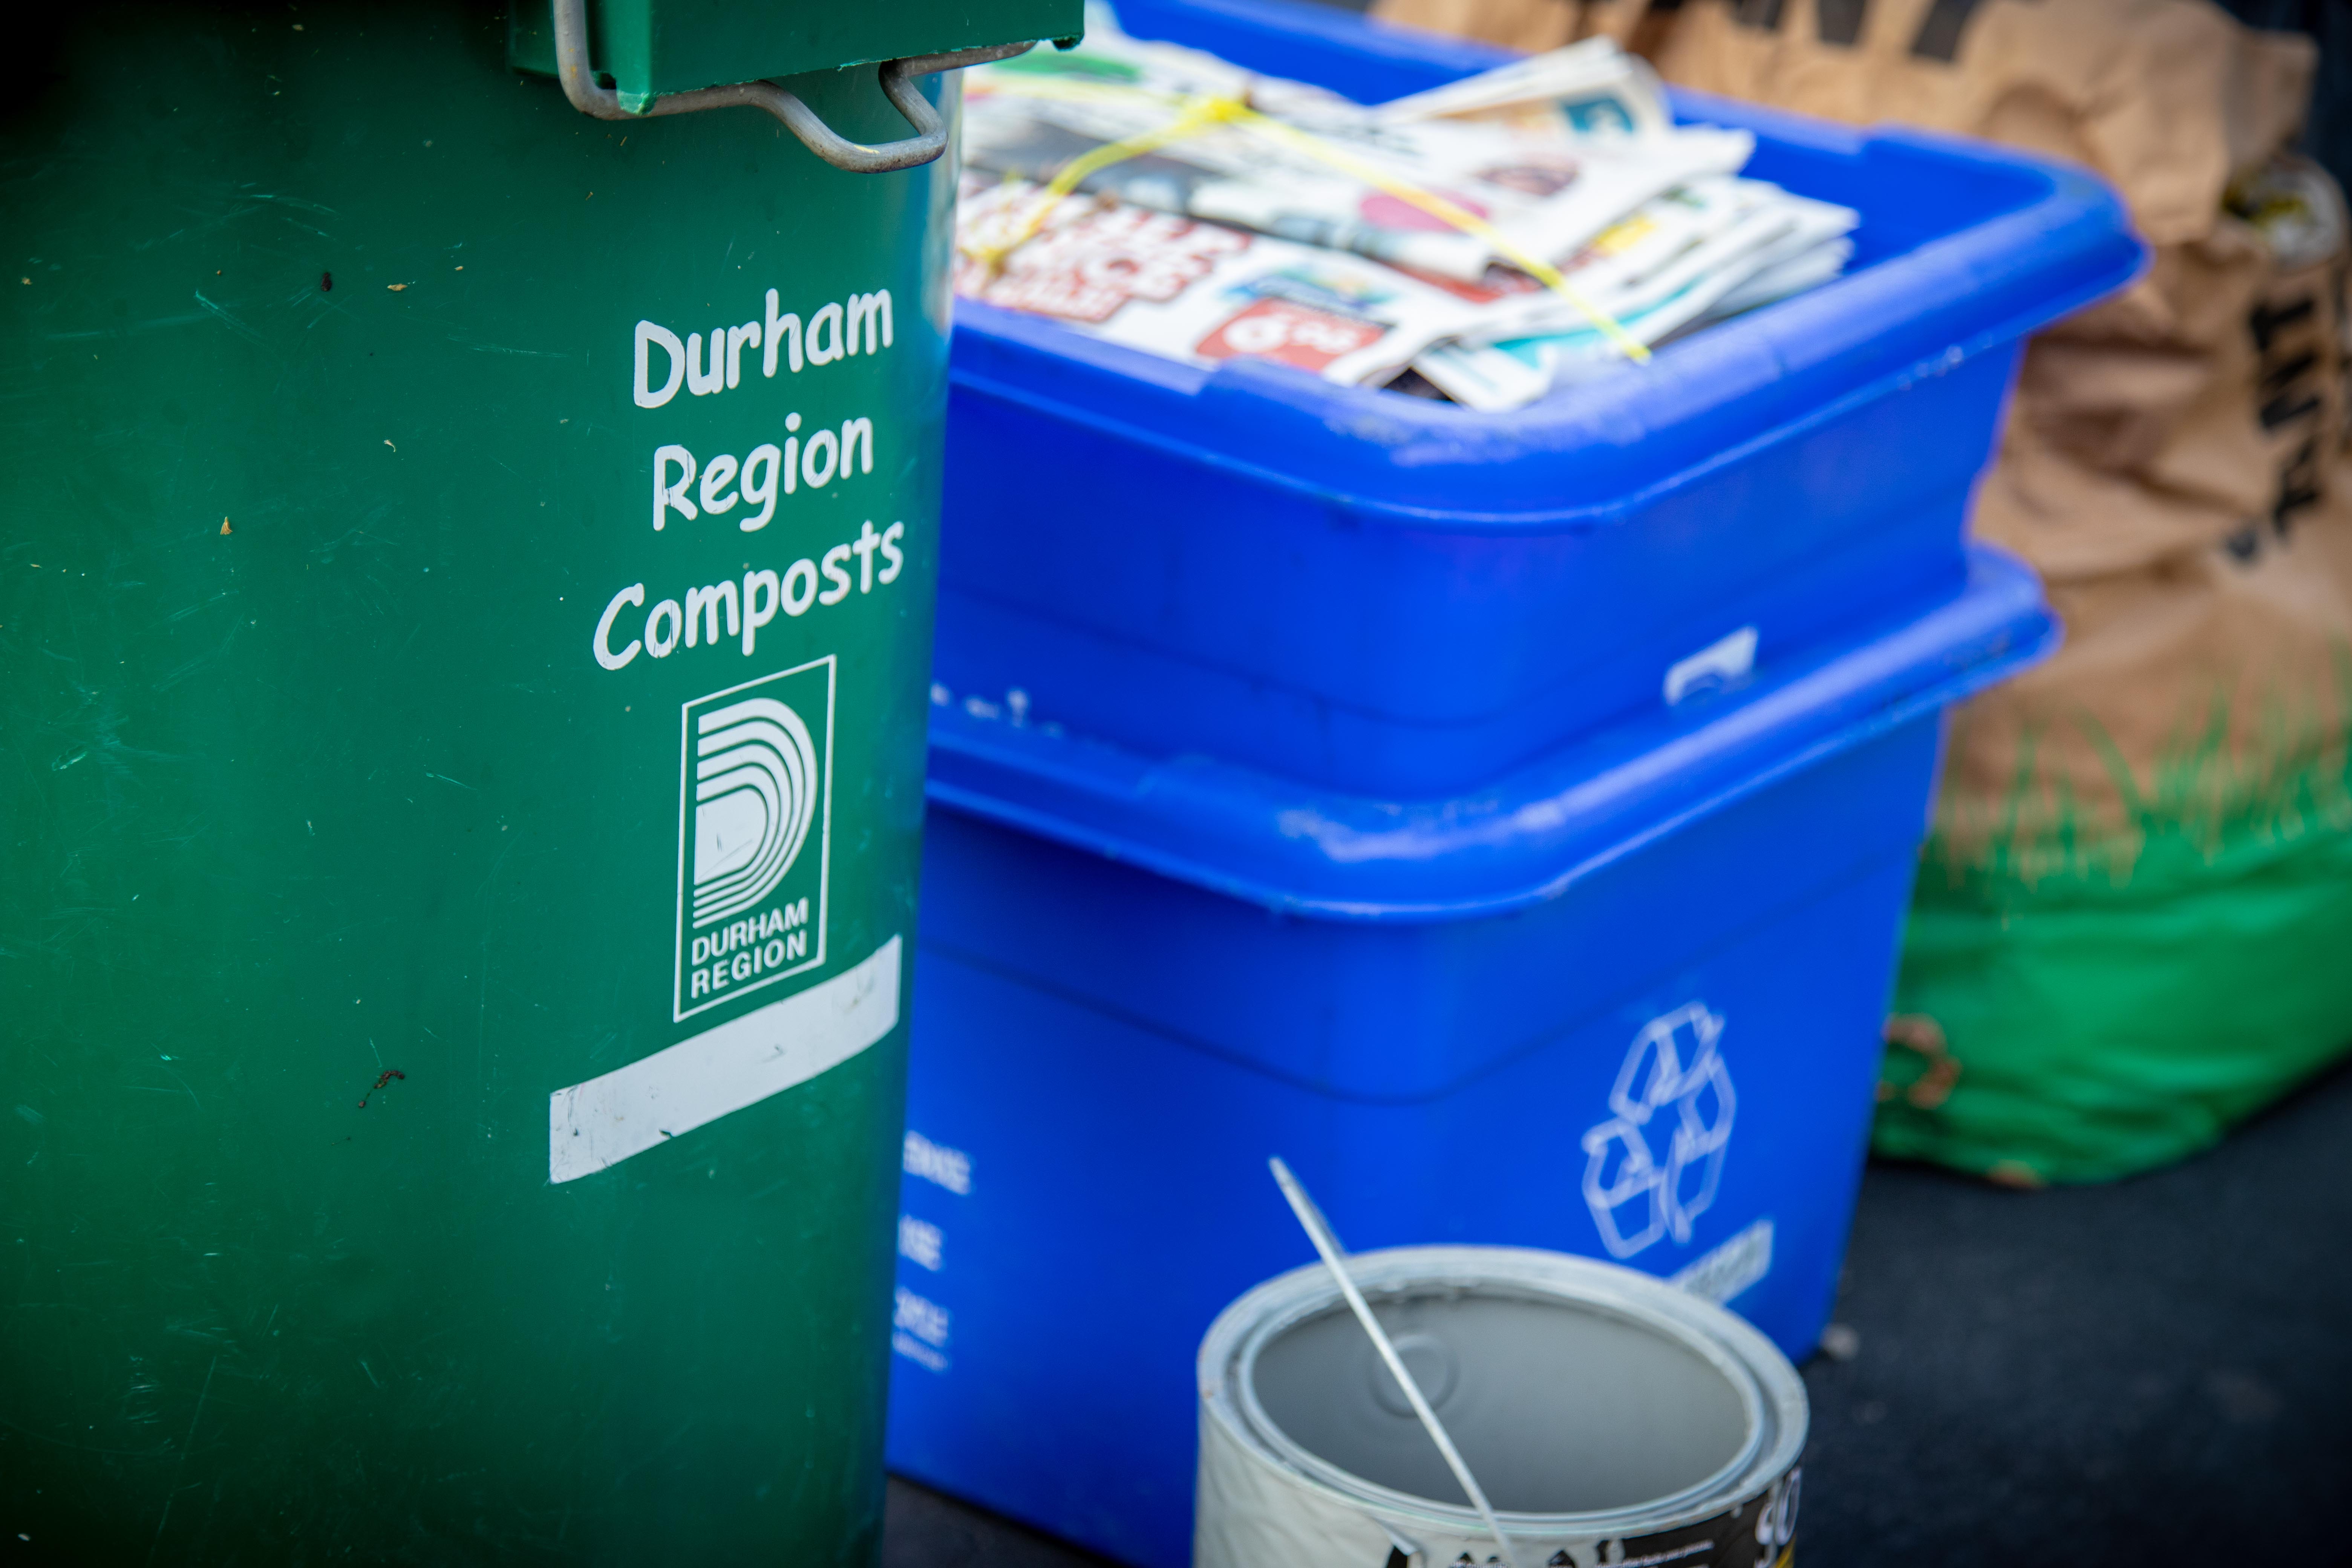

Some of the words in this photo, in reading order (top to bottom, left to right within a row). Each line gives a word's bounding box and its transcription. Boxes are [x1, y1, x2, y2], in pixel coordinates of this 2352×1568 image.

[633, 288, 893, 409] Durham
[653, 412, 873, 532] Region
[593, 520, 905, 671] Composts
[691, 930, 807, 998] REGION
[692, 898, 808, 966] DURHAM
